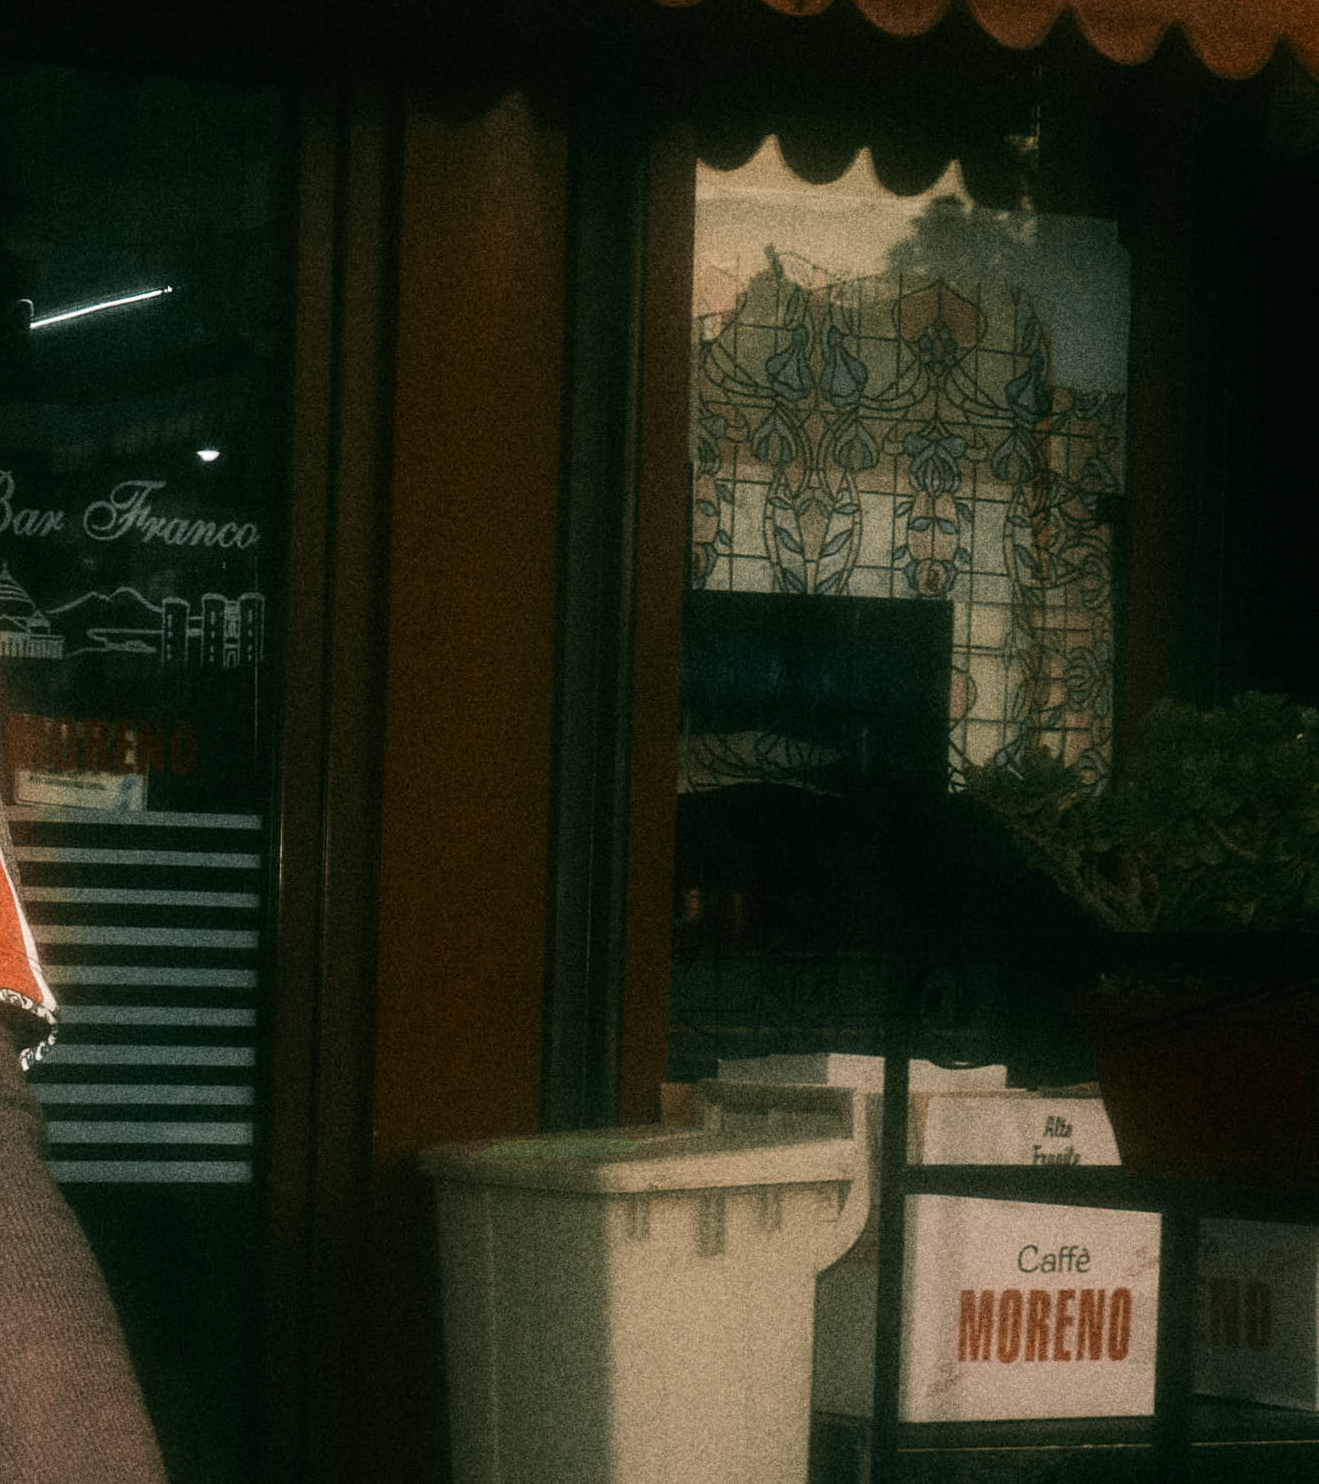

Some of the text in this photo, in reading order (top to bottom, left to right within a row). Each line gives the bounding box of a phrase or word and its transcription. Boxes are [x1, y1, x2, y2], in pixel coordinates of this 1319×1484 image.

[83, 479, 260, 549] Franco
[7, 713, 198, 777] MORENO
[1016, 1243, 1091, 1274] Caffè
[958, 1286, 1133, 1364] MORENO
